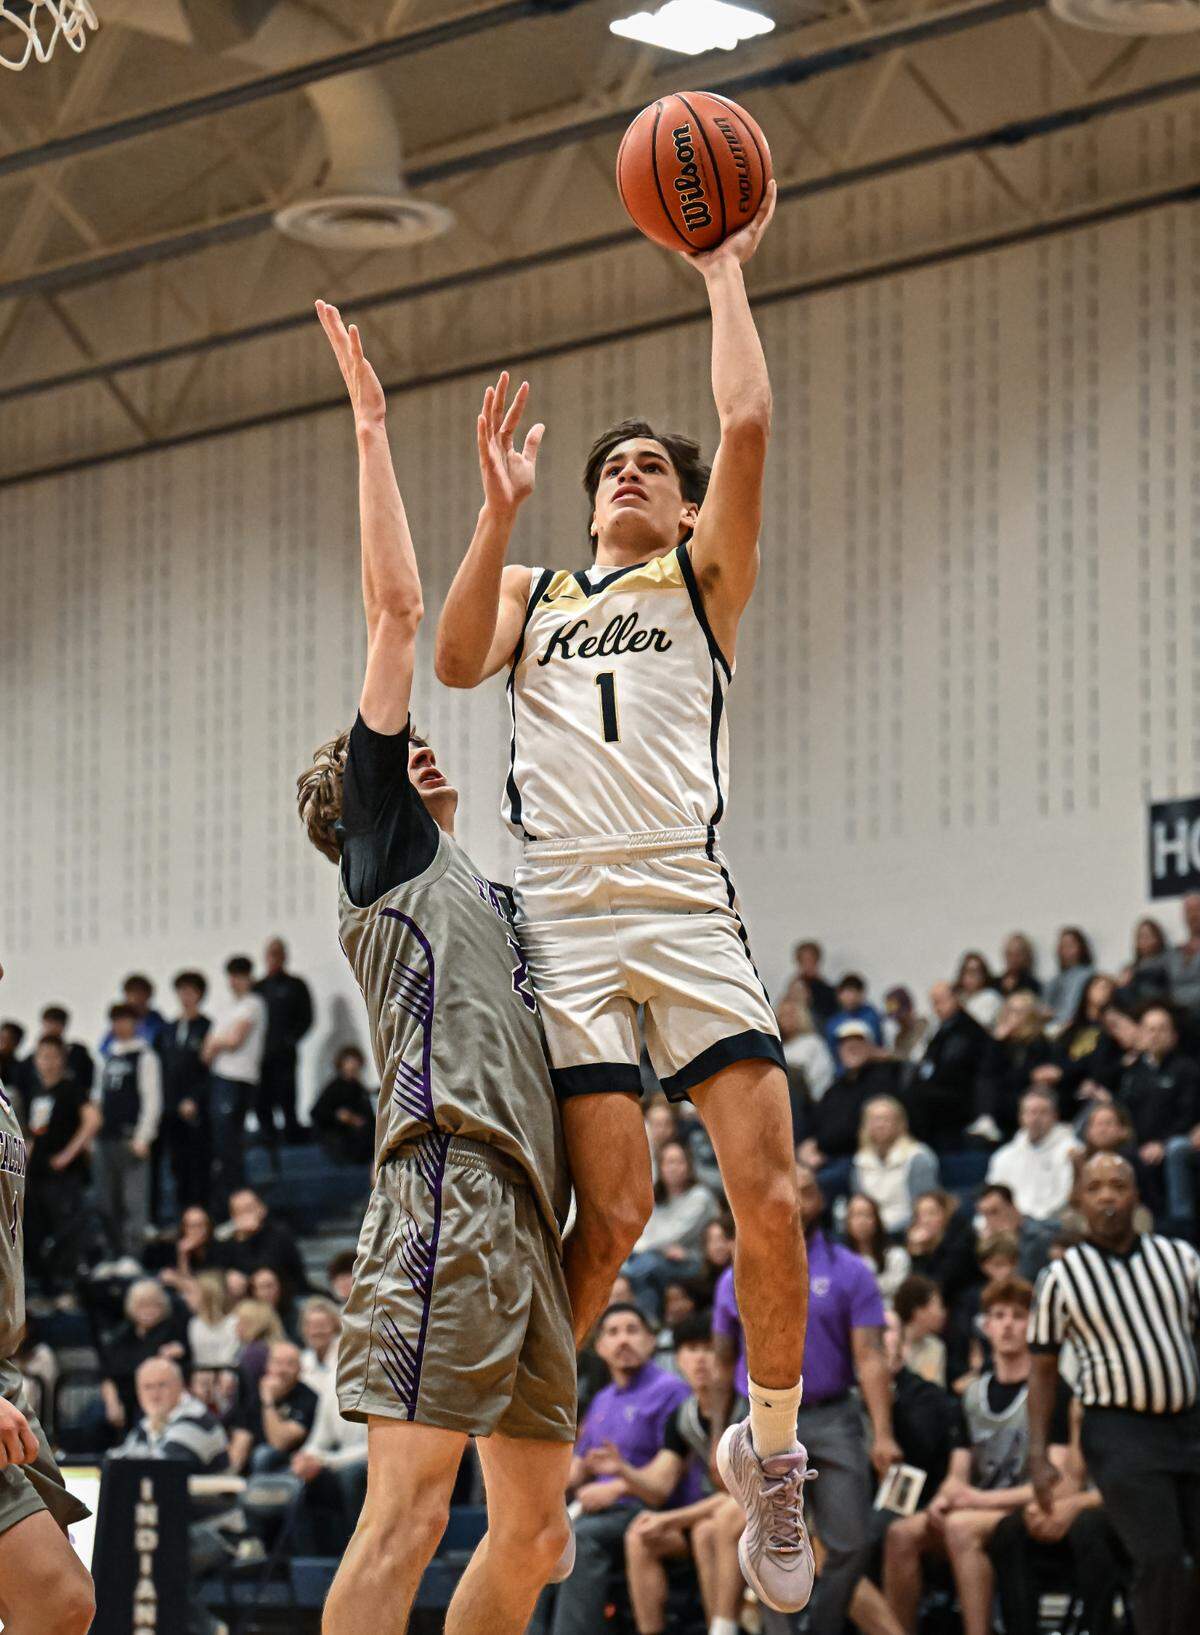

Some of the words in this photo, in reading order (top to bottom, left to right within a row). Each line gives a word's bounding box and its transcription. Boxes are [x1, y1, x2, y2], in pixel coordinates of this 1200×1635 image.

[672, 123, 713, 233] Wilson
[537, 611, 672, 667] Keller
[594, 670, 621, 743] 1
